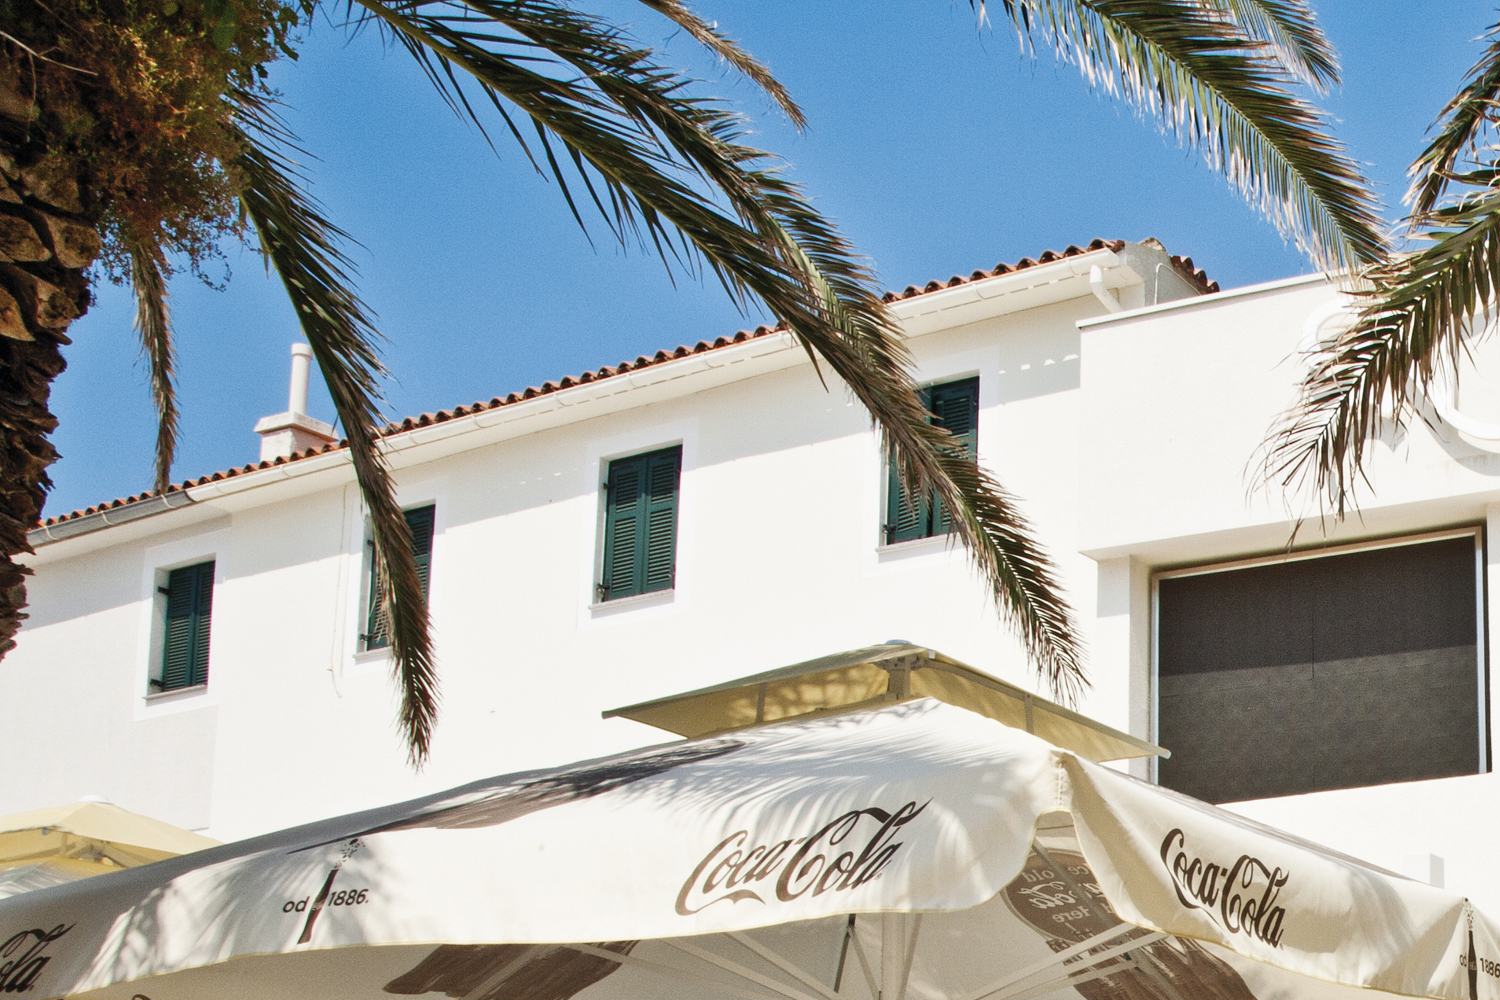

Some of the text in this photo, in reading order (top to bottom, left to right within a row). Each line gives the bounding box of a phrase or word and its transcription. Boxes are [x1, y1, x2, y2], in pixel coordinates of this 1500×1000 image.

[283, 897, 310, 913] od
[676, 797, 934, 916] Coca-Cola
[1160, 828, 1290, 950] Coca-Cola
